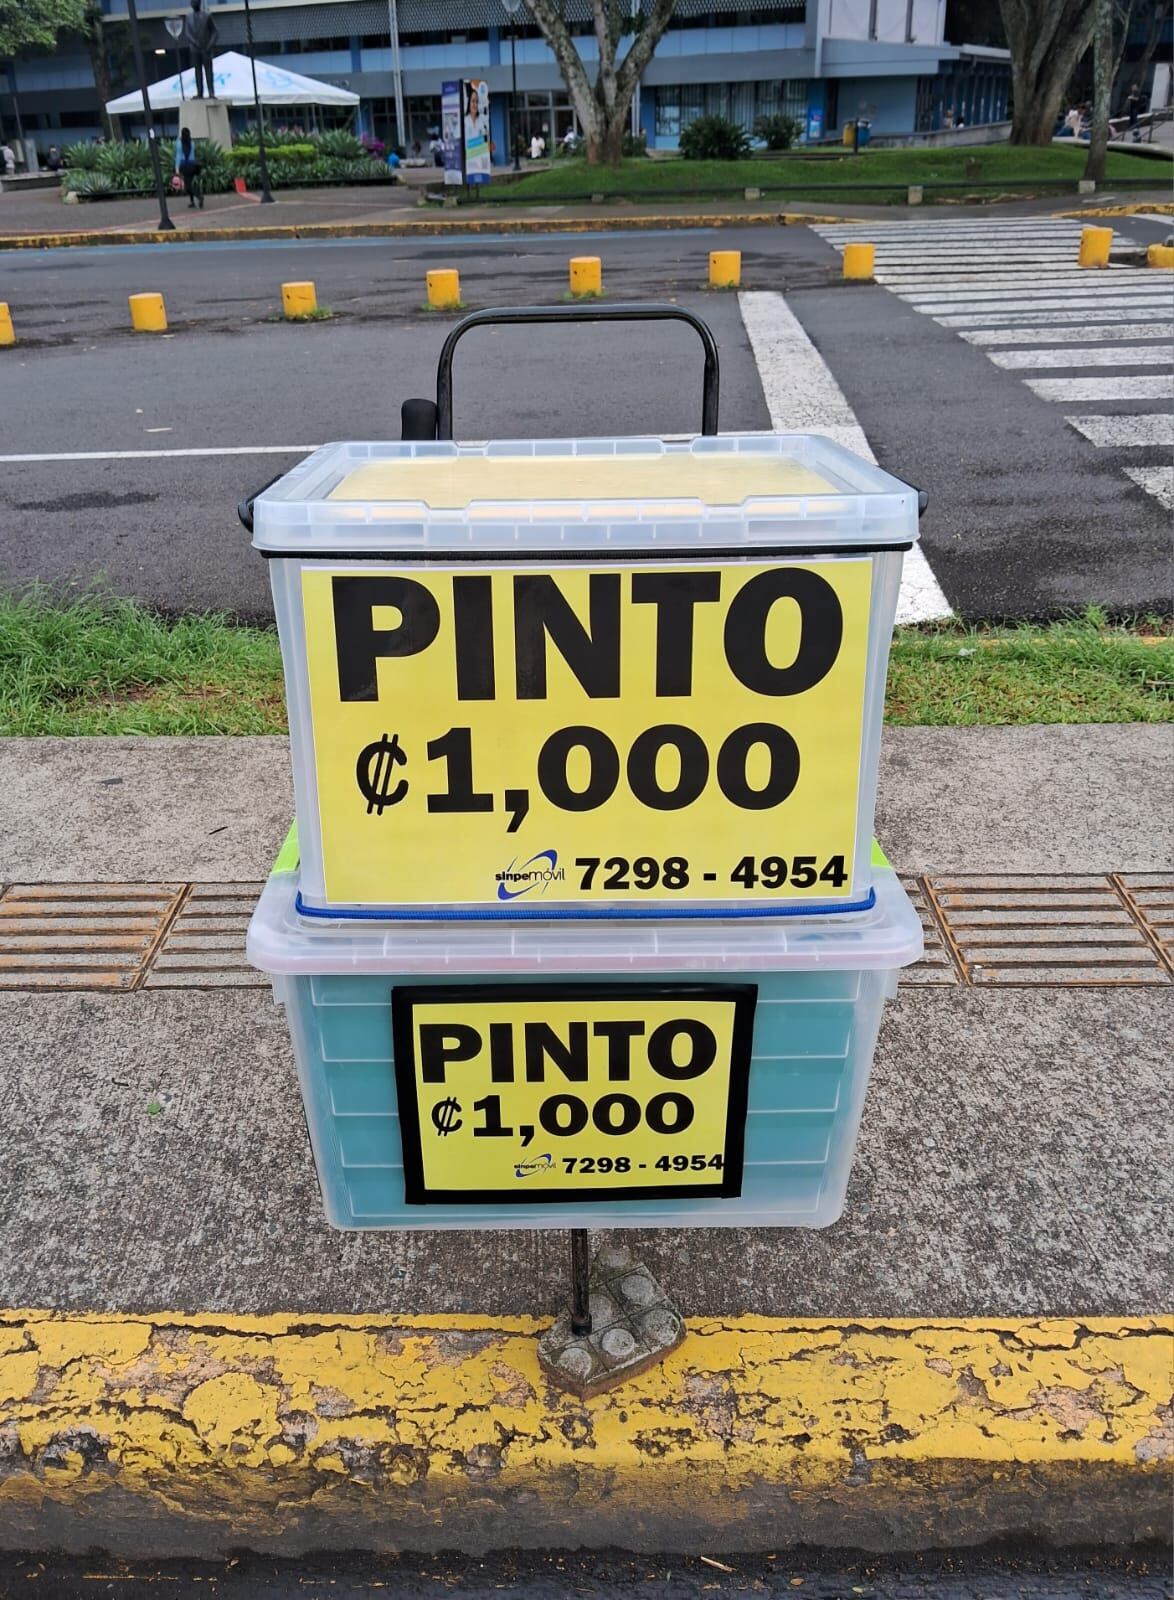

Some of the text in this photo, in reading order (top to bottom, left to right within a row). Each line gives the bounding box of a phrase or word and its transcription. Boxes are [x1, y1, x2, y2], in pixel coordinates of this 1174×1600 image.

[331, 567, 844, 703] PINTO
[575, 856, 690, 891] 7298
[703, 872, 717, 881] -
[730, 855, 849, 889] 4954
[418, 1018, 718, 1084] PINTO
[561, 1156, 632, 1174] 7298
[654, 1153, 725, 1172] 4954
